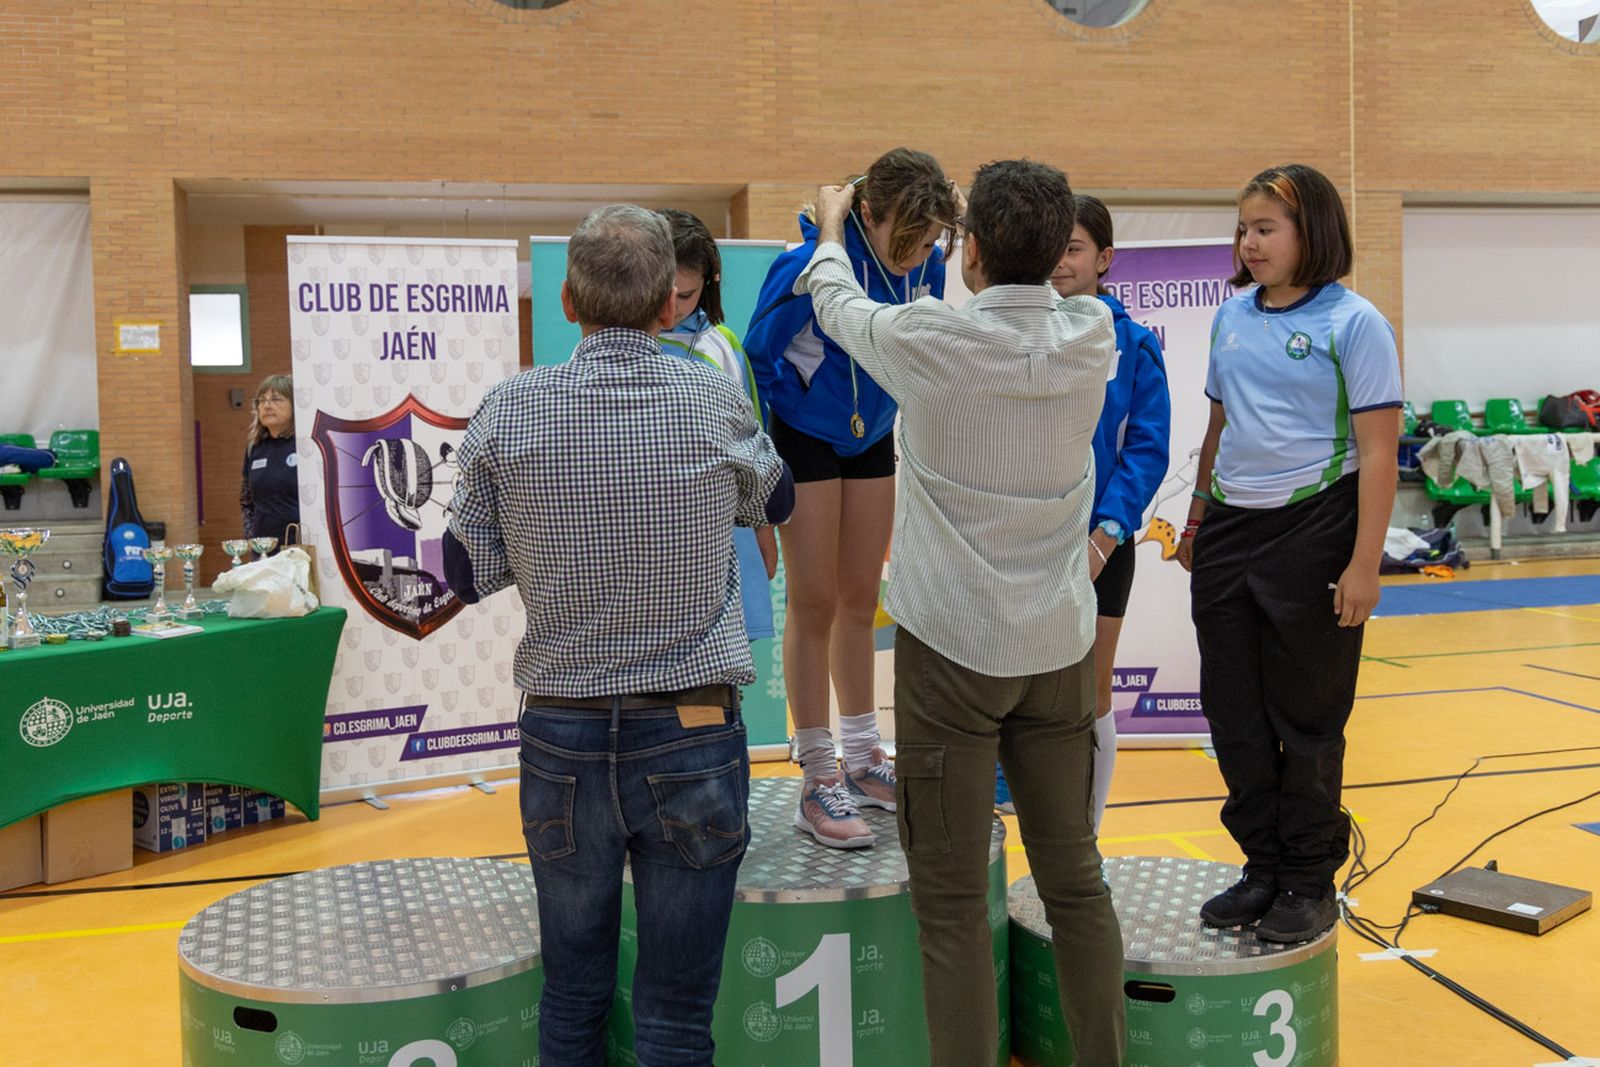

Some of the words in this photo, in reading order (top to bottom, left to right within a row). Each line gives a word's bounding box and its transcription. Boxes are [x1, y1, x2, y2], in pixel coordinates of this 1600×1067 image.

[299, 283, 361, 312] CLUB
[370, 284, 399, 312] DE
[407, 284, 509, 313] ESGRIMA
[1139, 281, 1233, 309] ESGRIMA
[380, 326, 436, 361] JAÉN
[433, 589, 455, 608] Esgri
[76, 698, 135, 716] Universidad
[148, 710, 193, 723] Deporte
[1157, 699, 1201, 711] CLUBDEES
[77, 714, 89, 724] de
[92, 710, 115, 722] Jaén
[775, 933, 853, 1067] 1
[1253, 989, 1297, 1067] 3
